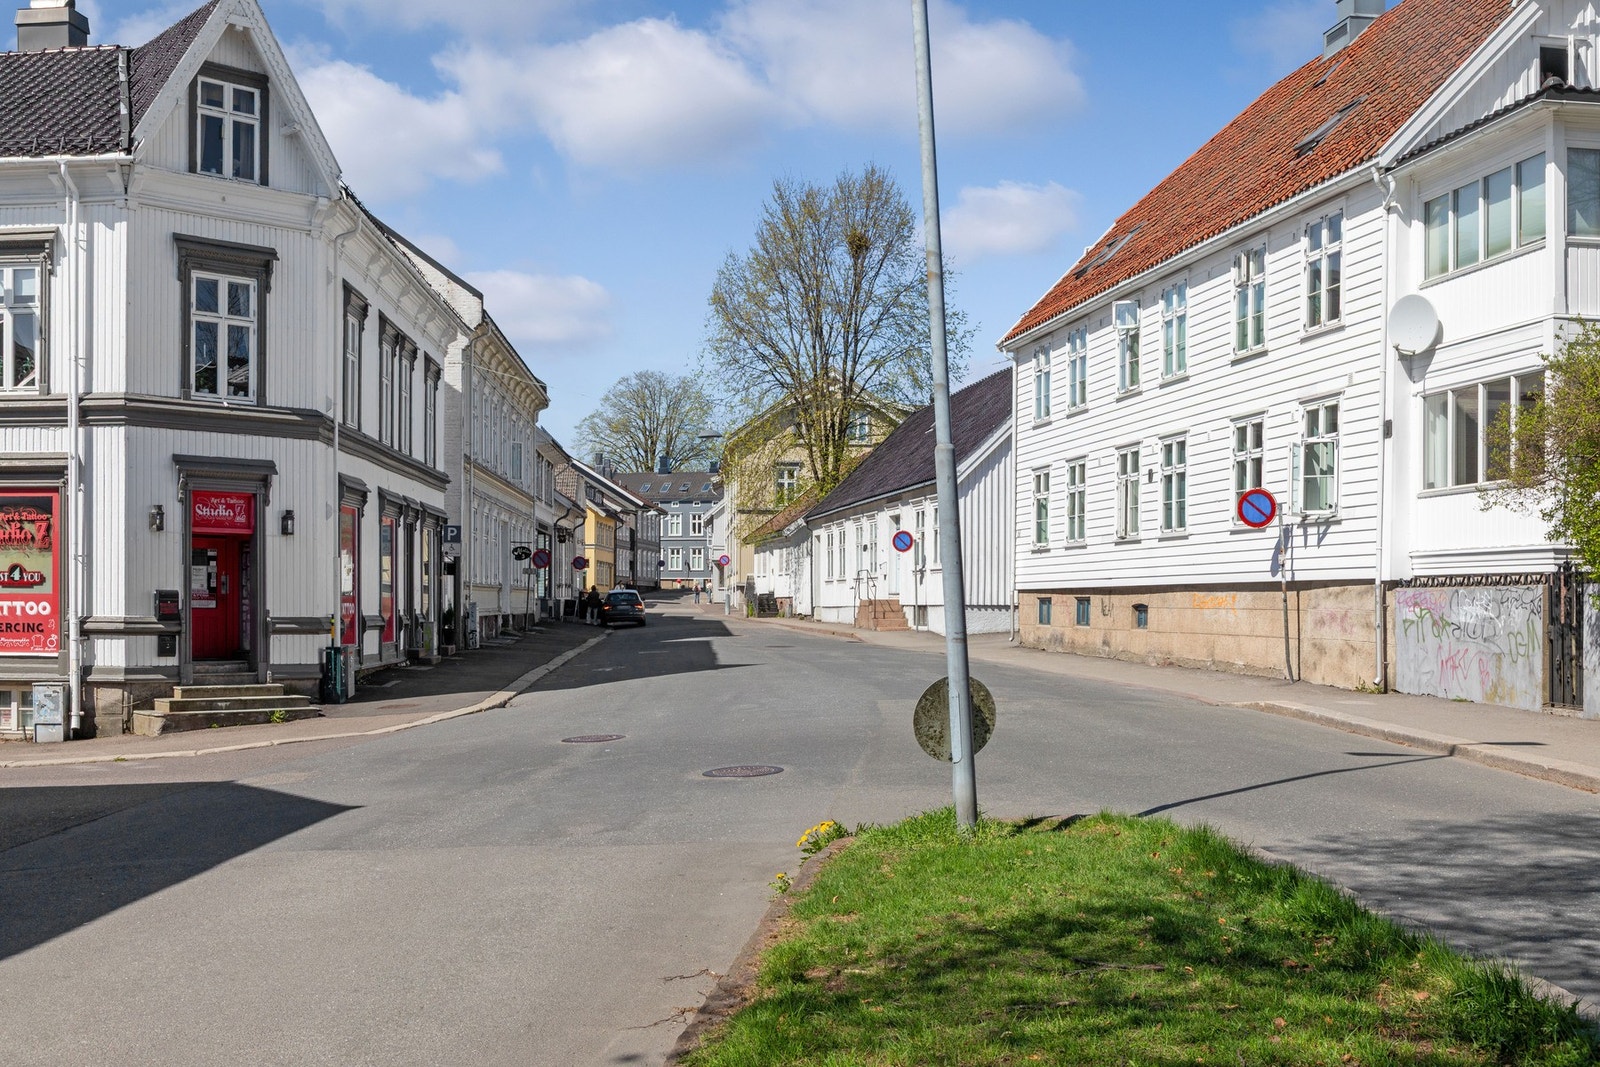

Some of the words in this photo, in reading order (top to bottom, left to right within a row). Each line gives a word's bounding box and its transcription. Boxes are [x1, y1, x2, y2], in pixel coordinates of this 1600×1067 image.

[22, 512, 47, 520] Tattoo
[195, 503, 234, 517] Studio
[234, 503, 246, 522] Z
[34, 521, 50, 549] Z
[447, 527, 457, 541] P
[10, 567, 21, 581] 4
[23, 573, 41, 581] YOU
[0, 601, 51, 616] TTOO
